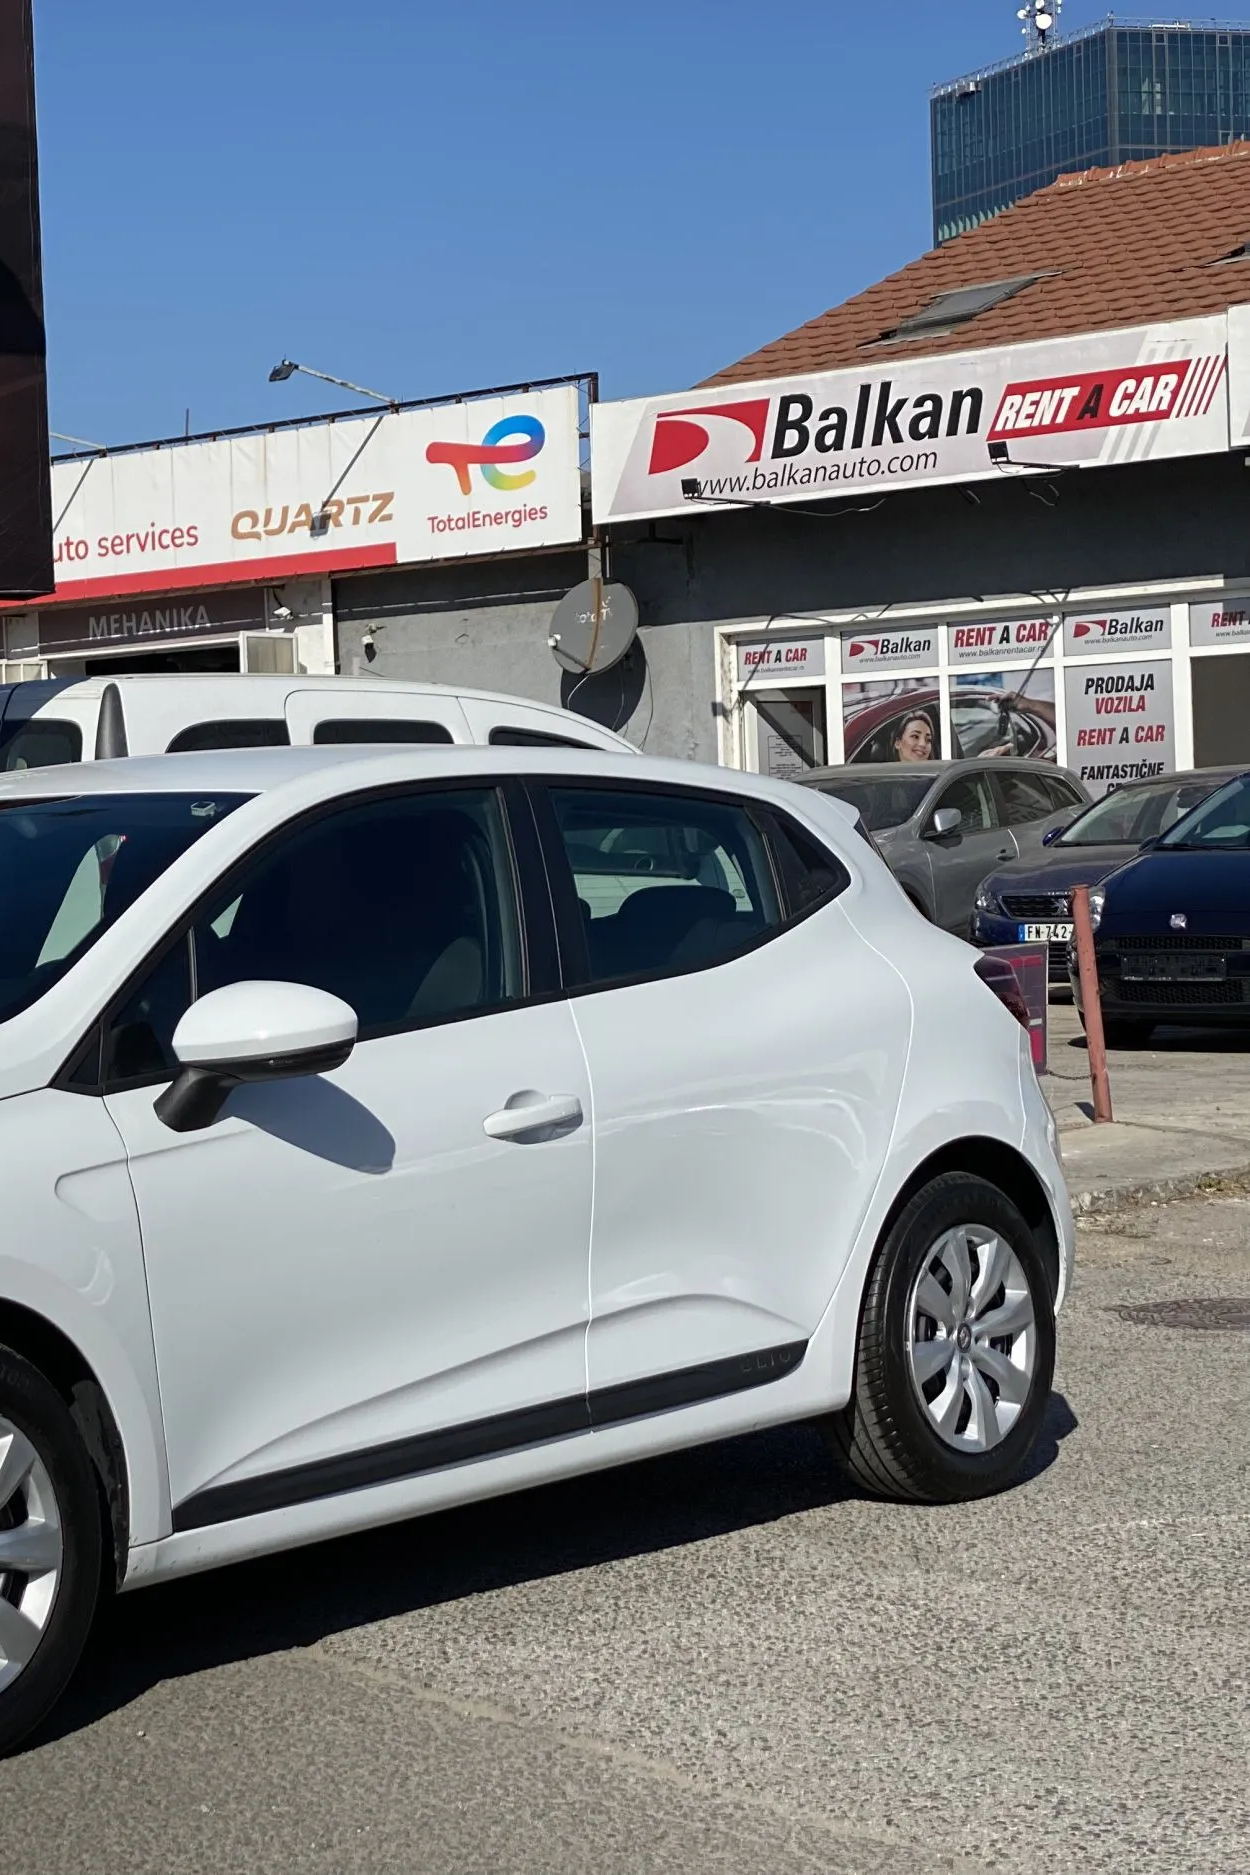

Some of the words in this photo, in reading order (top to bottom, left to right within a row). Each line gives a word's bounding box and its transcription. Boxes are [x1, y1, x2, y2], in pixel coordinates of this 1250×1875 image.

[994, 386, 1081, 432] RENT
[1076, 384, 1104, 421] A
[1108, 373, 1179, 418] CAR
[770, 380, 983, 460] Balkan
[230, 491, 396, 541] QUARTZ
[427, 503, 549, 534] TotalEnergies
[53, 534, 90, 563] uto
[97, 521, 200, 558] services
[88, 604, 211, 640] MEHANIKA
[1108, 618, 1165, 636] Balkan
[1211, 611, 1246, 628] RENT
[955, 626, 997, 648] RENT
[998, 625, 1011, 644] A
[1015, 621, 1049, 643] CAR
[744, 650, 772, 665] RENT
[774, 649, 782, 664] A
[785, 647, 808, 662] CAR
[880, 638, 931, 655] Balkan
[1084, 673, 1155, 695] PRODAJA
[1095, 694, 1146, 715] VOZILA
[1077, 727, 1116, 746] RENT
[1118, 727, 1129, 744] A
[1134, 724, 1166, 743] CAR
[1080, 759, 1165, 781] FANTASTIČNE
